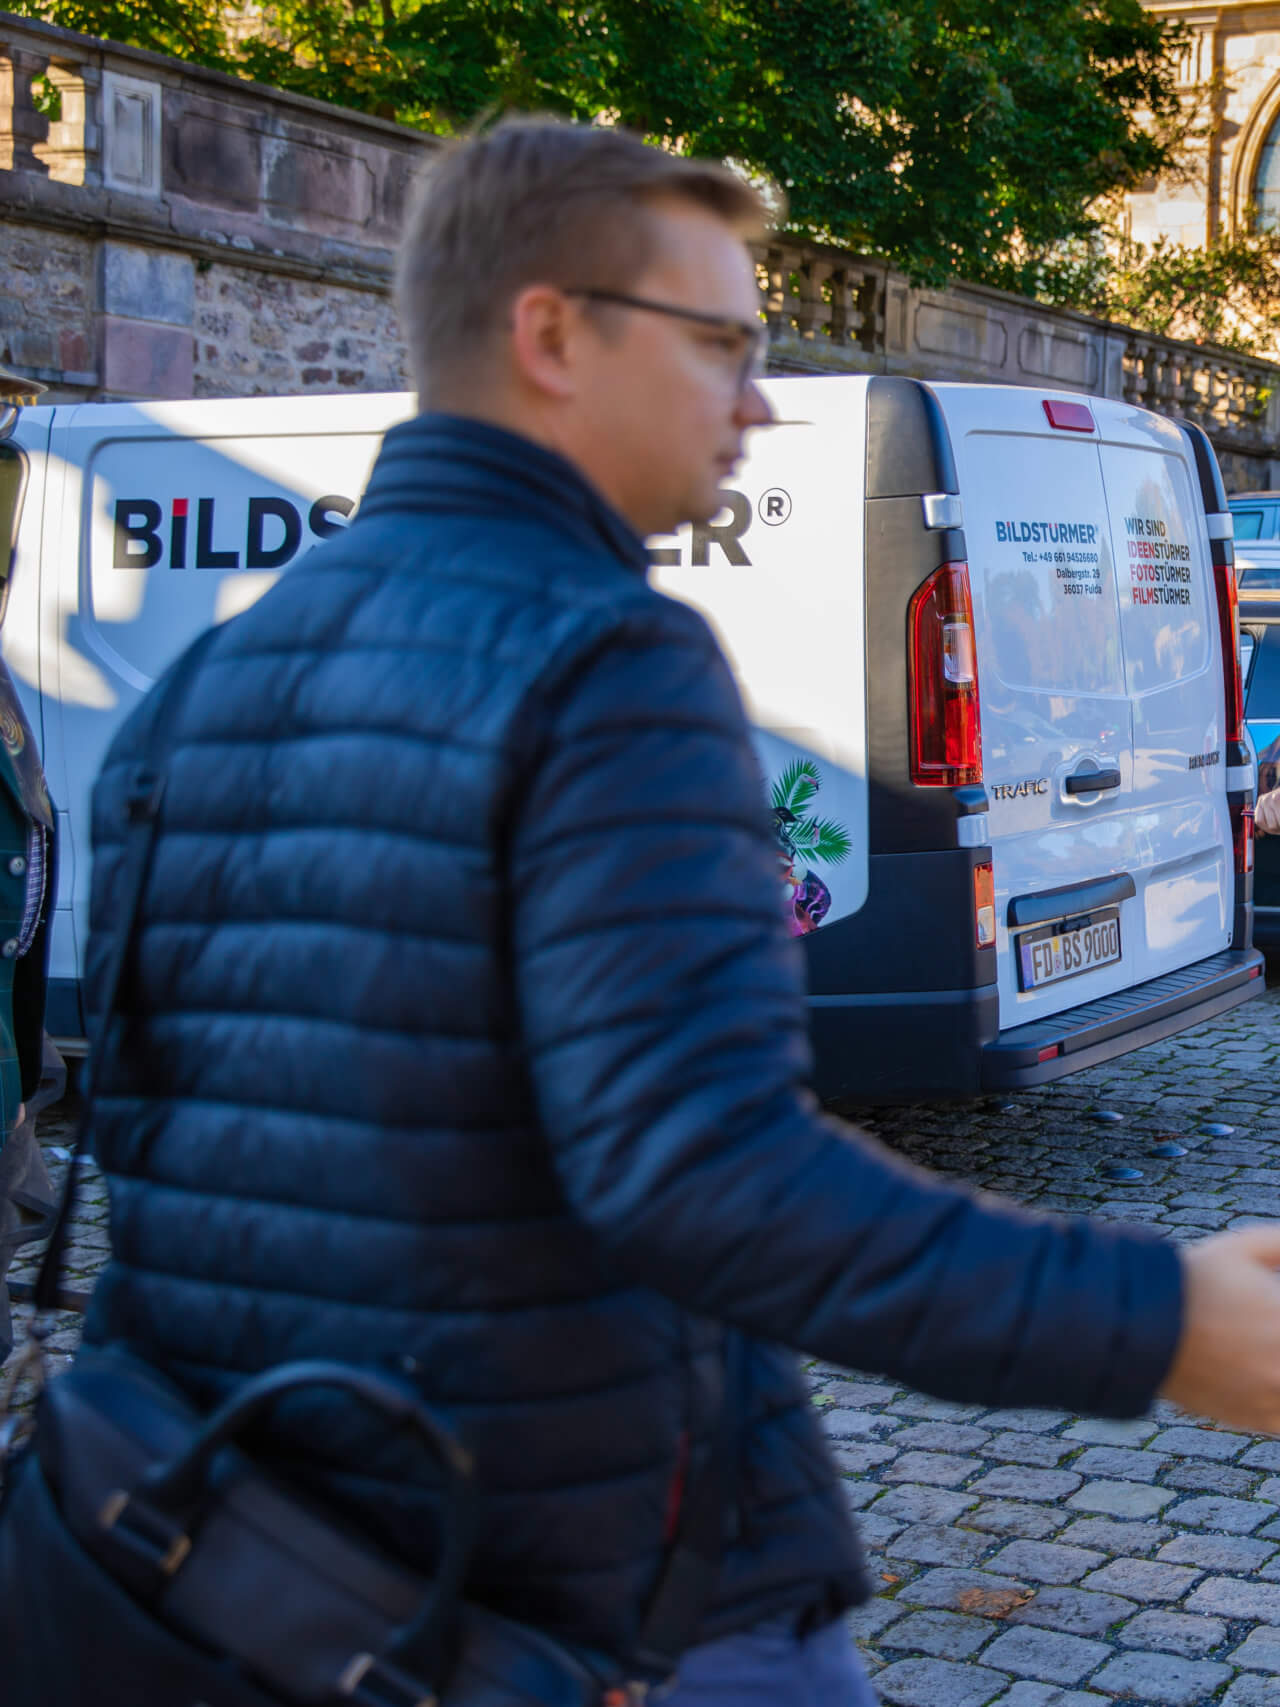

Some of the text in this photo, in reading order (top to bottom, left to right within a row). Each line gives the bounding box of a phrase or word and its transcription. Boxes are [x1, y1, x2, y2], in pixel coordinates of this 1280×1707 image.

[1124, 517, 1166, 537] WIR SIND
[1039, 552, 1053, 562] +49
[1054, 552, 1066, 562] 661
[1127, 538, 1191, 561] IDEENSTÜRMER
[1056, 568, 1092, 580] Dalbergstr.
[1130, 561, 1191, 583] FOTOSTÜRMER
[1085, 584, 1102, 595] Fulda
[1132, 584, 1191, 605] FILMSTÜRMER
[991, 778, 1048, 800] TRAFIC
[1032, 923, 1117, 980] FD BS 9000
